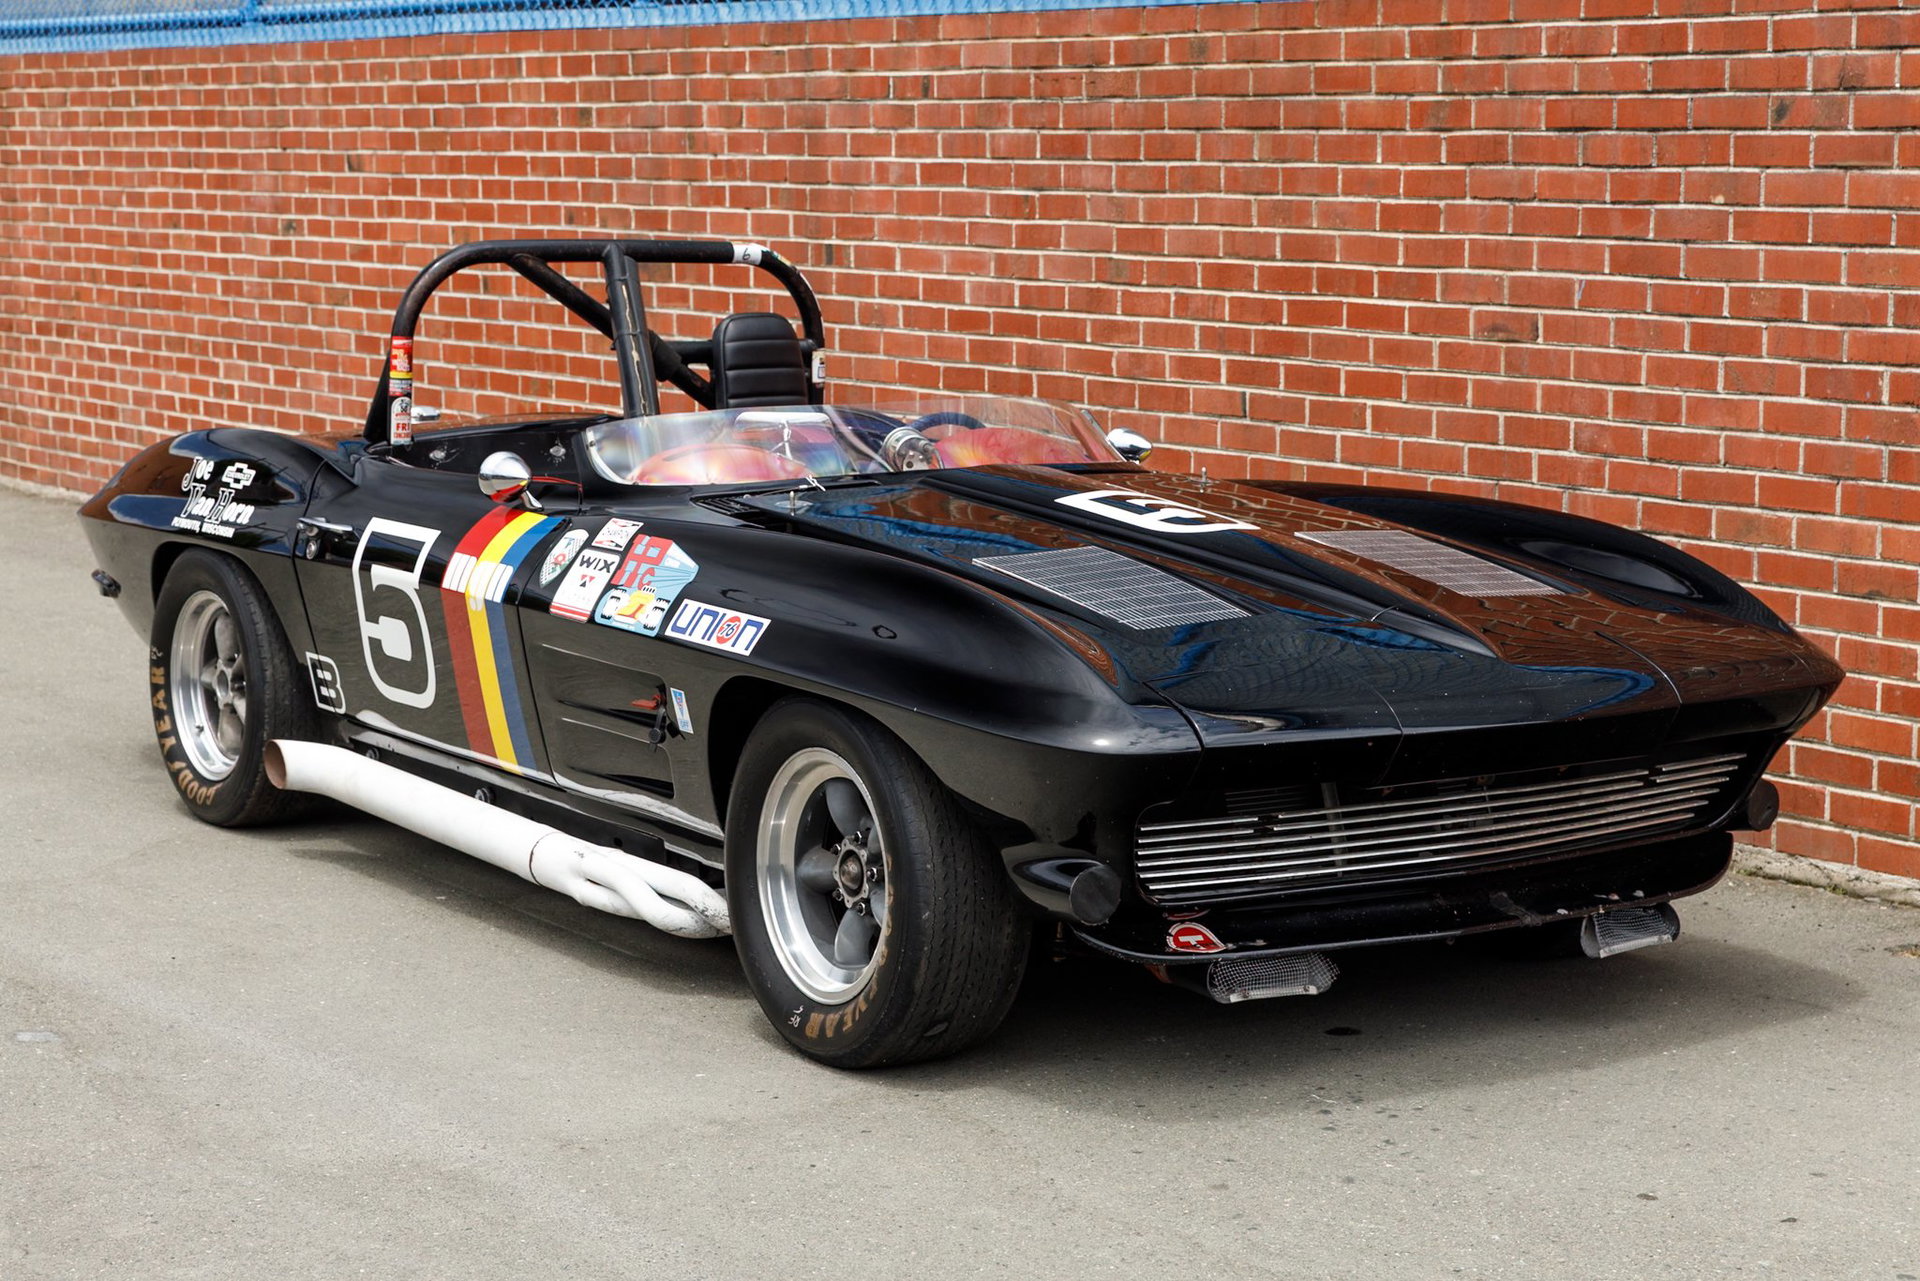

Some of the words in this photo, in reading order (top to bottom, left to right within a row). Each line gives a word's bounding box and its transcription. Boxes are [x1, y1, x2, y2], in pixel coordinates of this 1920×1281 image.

[181, 456, 215, 492] Joe
[578, 554, 616, 574] WIX
[352, 516, 442, 709] 5
[720, 622, 736, 637] 76
[305, 651, 346, 714] B
